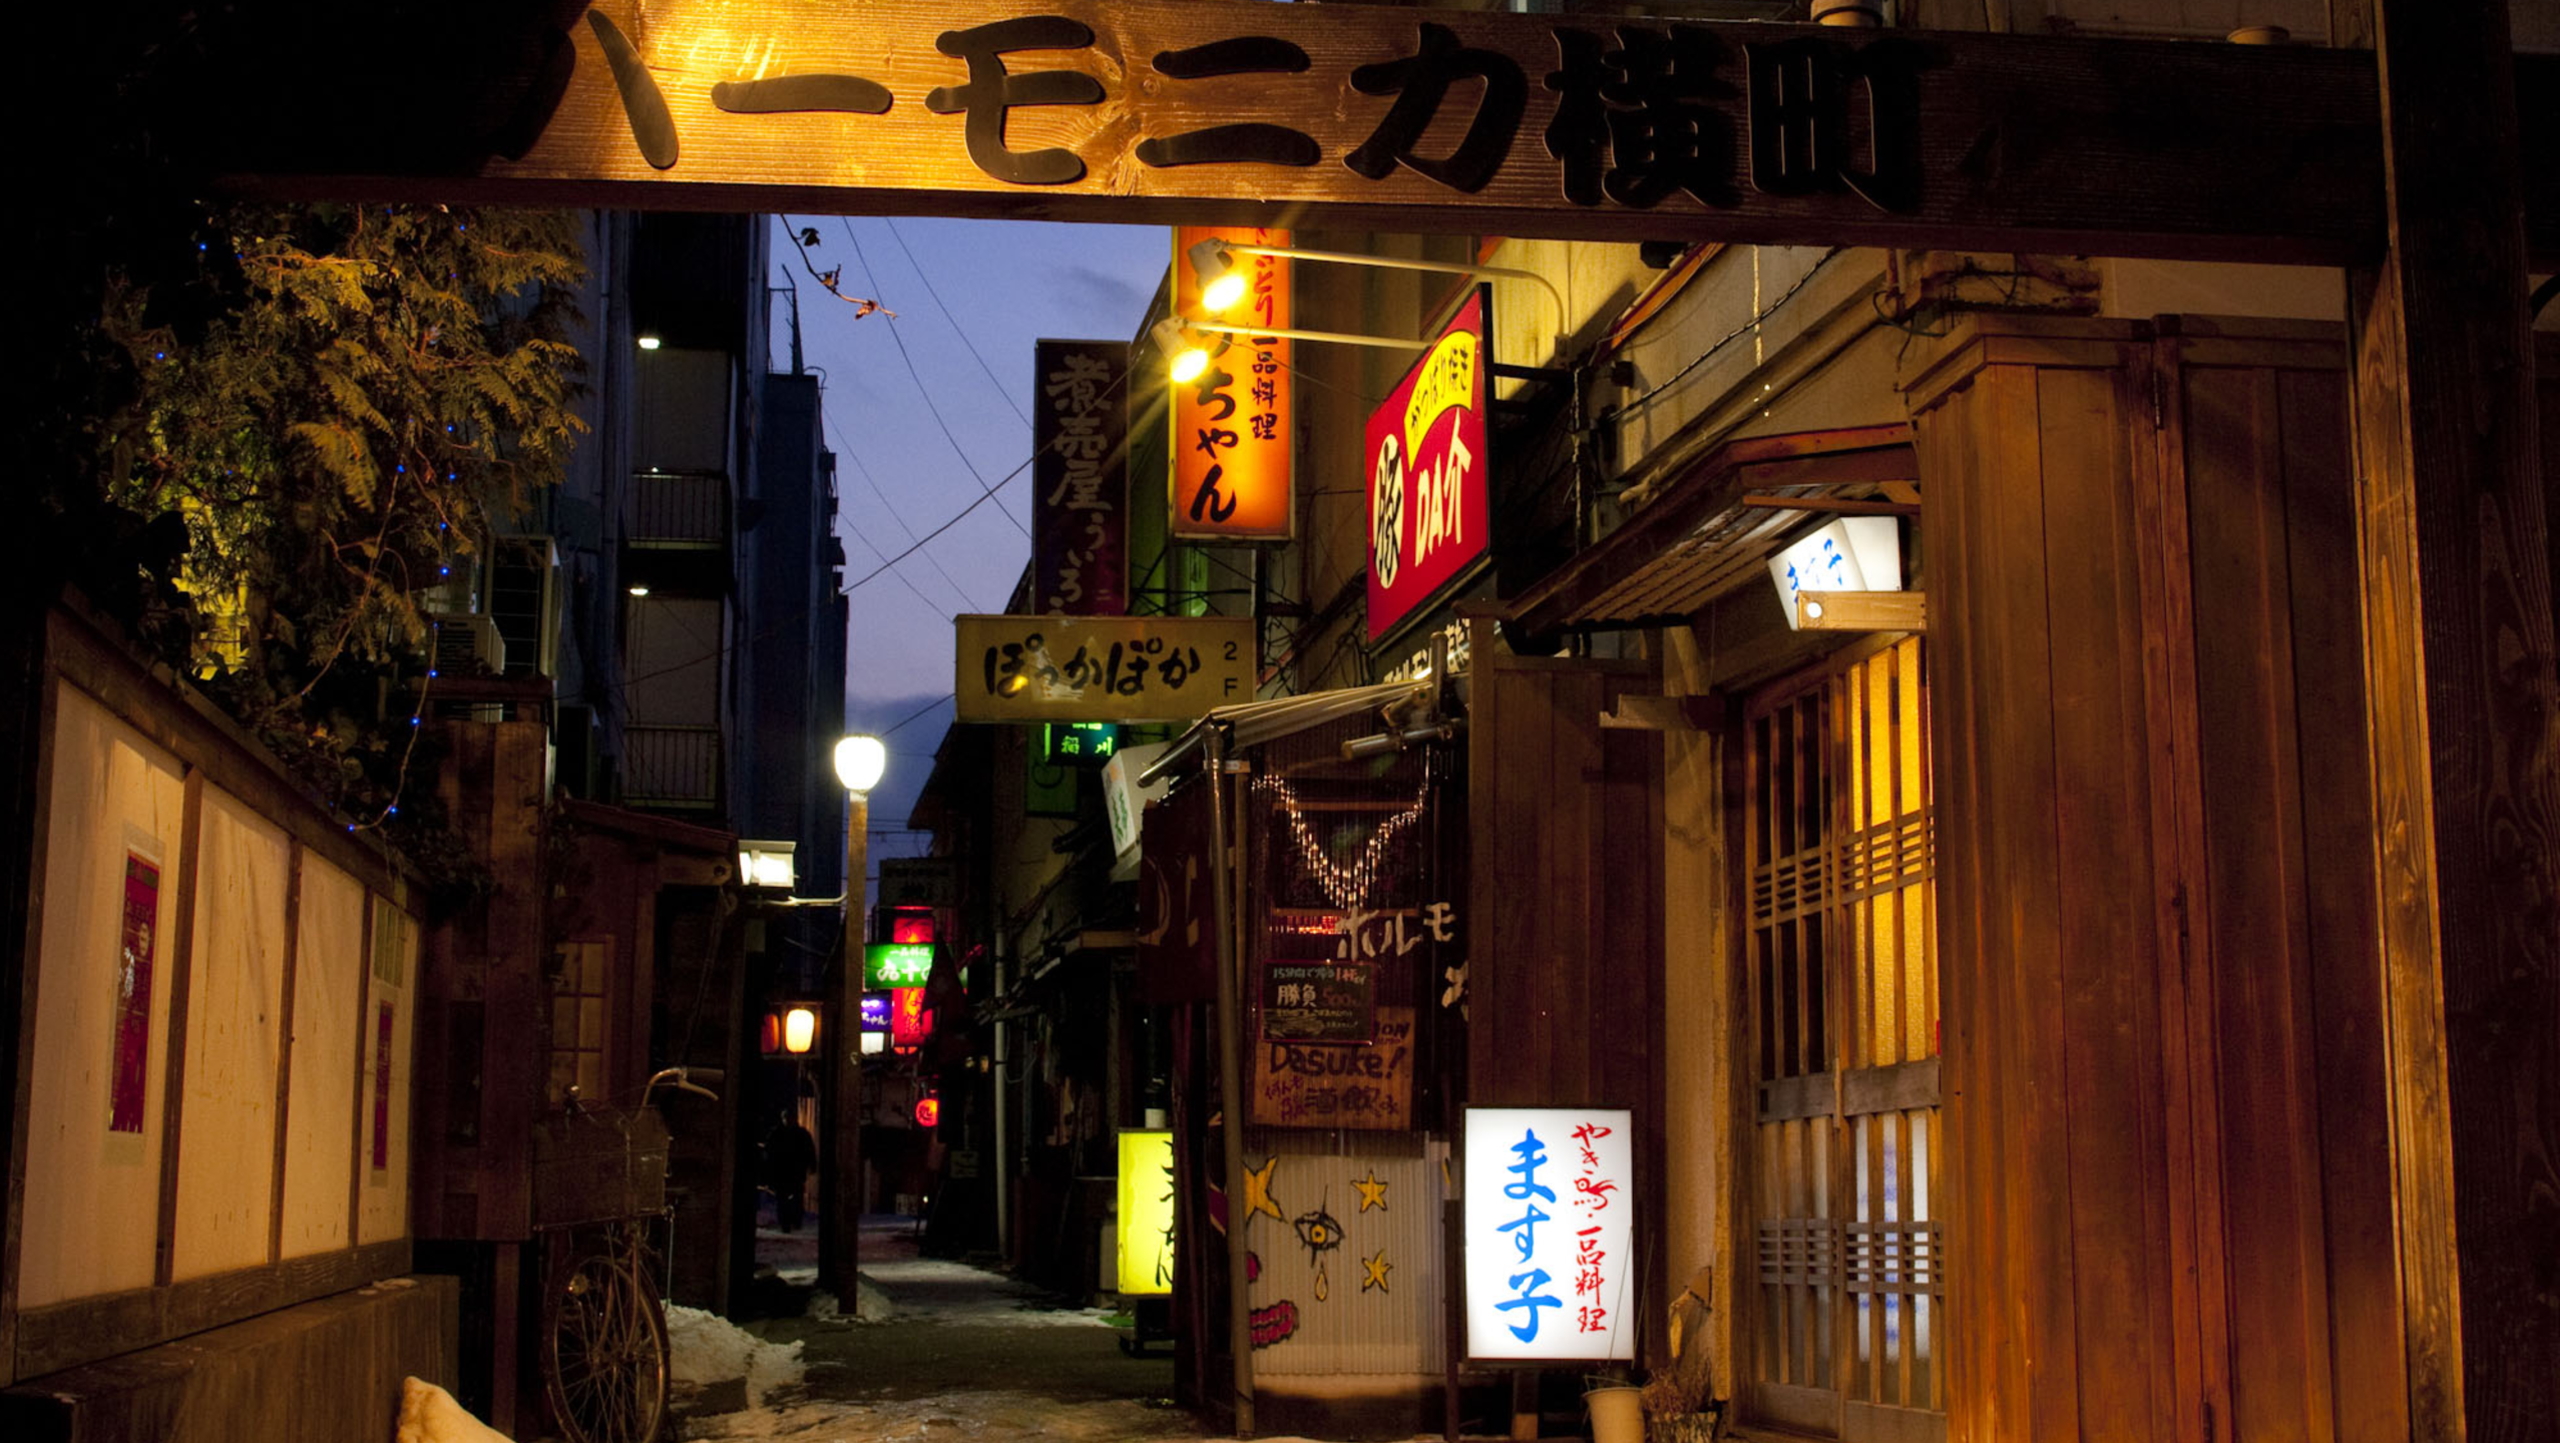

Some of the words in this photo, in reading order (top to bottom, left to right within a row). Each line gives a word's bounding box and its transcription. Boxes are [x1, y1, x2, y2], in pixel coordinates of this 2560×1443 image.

[490, 8, 1954, 215] ハーモニカ横町
[1494, 1128, 1563, 1343] ます子
